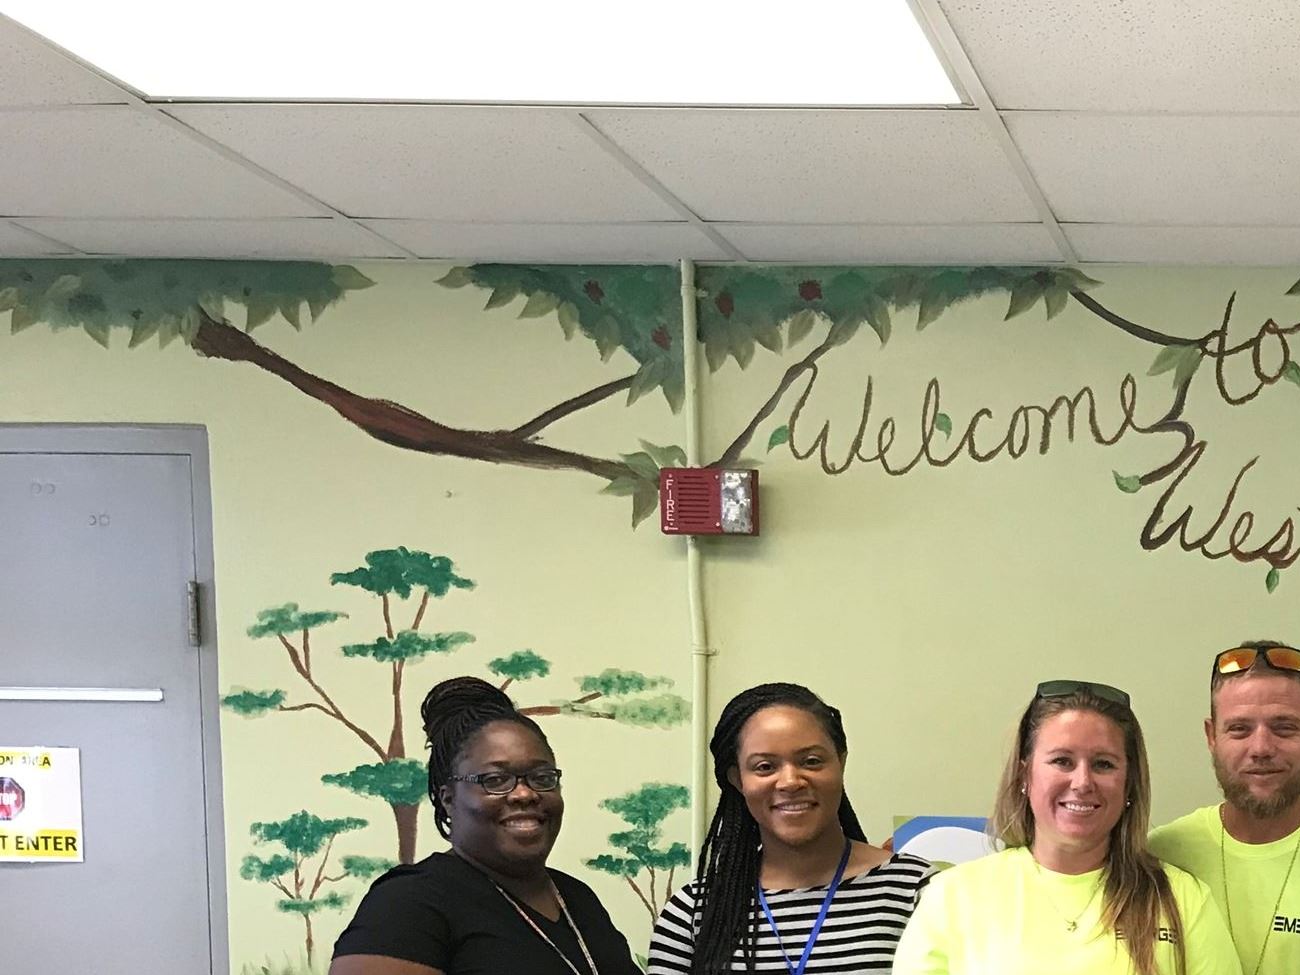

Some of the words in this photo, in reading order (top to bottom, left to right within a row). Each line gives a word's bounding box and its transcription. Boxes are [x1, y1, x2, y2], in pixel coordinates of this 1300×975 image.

[788, 364, 1154, 475] Welcome
[1203, 292, 1290, 404] to
[666, 479, 675, 522] FIRE
[15, 835, 77, 851] ENTER
